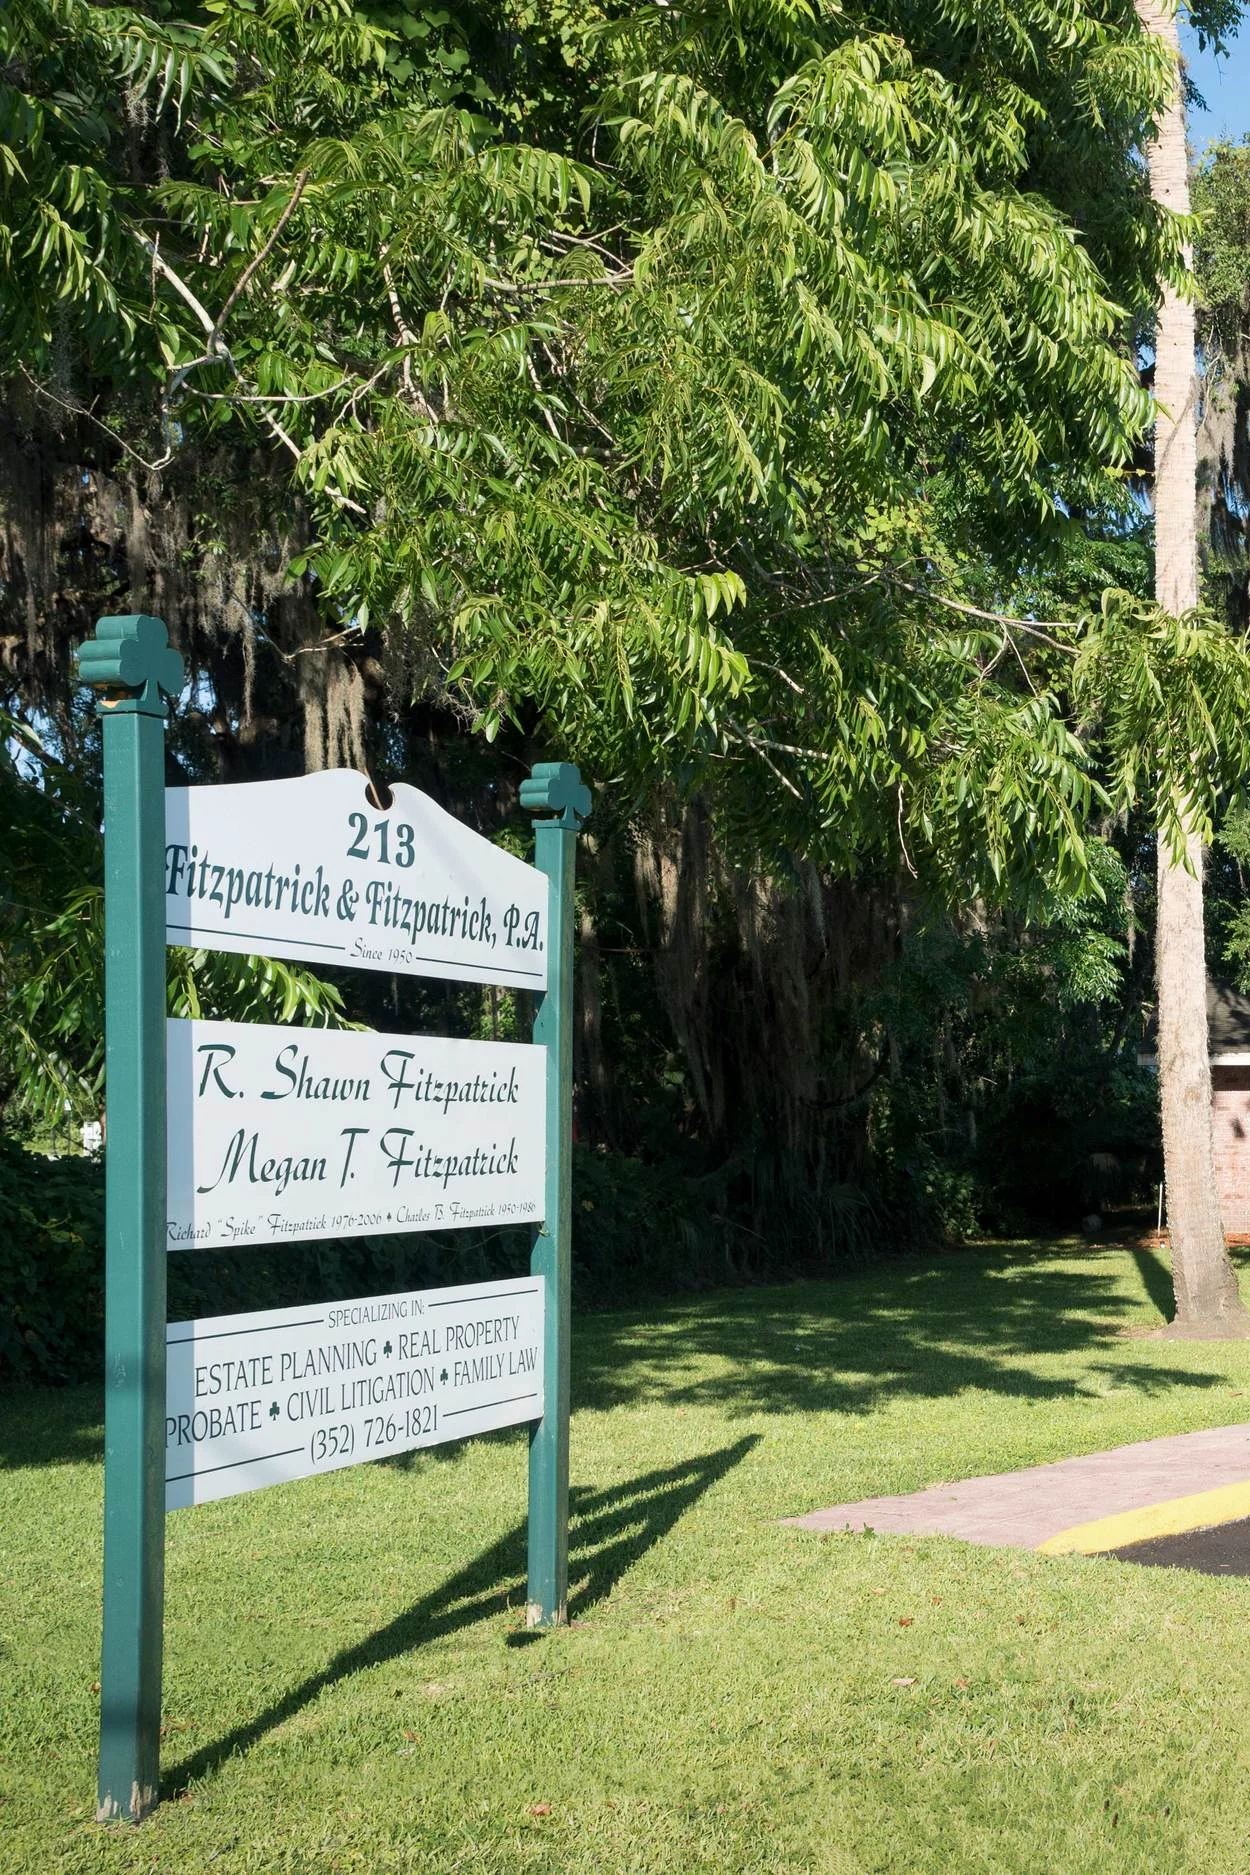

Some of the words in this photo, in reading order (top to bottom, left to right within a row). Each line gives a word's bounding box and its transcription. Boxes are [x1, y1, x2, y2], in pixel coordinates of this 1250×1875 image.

[347, 812, 415, 868] 213
[165, 844, 330, 919] Fitzpatrick
[336, 878, 359, 922] &
[366, 881, 497, 950] Fitzpatrick,
[503, 903, 544, 951] P.A.
[350, 937, 383, 961] Since
[388, 948, 413, 964] 1950
[197, 1044, 244, 1099] R.
[261, 1044, 371, 1101] Shawn
[380, 1049, 519, 1114] Fitzpatrick
[196, 1128, 327, 1196] Megan
[340, 1128, 370, 1189] T.
[380, 1127, 519, 1189] Fitzpatrick
[166, 1221, 212, 1241] Richard
[267, 1212, 327, 1236] Fitzpatrick
[331, 1211, 382, 1231] 1976-2006
[396, 1205, 430, 1224] Charles
[449, 1201, 495, 1222] Fitzpatrick
[328, 1301, 408, 1328] SPECIALIZING
[410, 1299, 425, 1317] IN:
[195, 1355, 273, 1398] ESTATE
[281, 1338, 378, 1382] PLANNING
[398, 1331, 441, 1361] REAL
[446, 1315, 520, 1348] PROPERTY
[165, 1400, 262, 1449] PROBATE
[286, 1387, 335, 1422] CIVIL
[341, 1366, 435, 1411] LITIGATION
[454, 1354, 504, 1387] FAMILY
[509, 1346, 538, 1376] LAW
[311, 1423, 355, 1465] (352)
[365, 1404, 439, 1447] 726-1821
